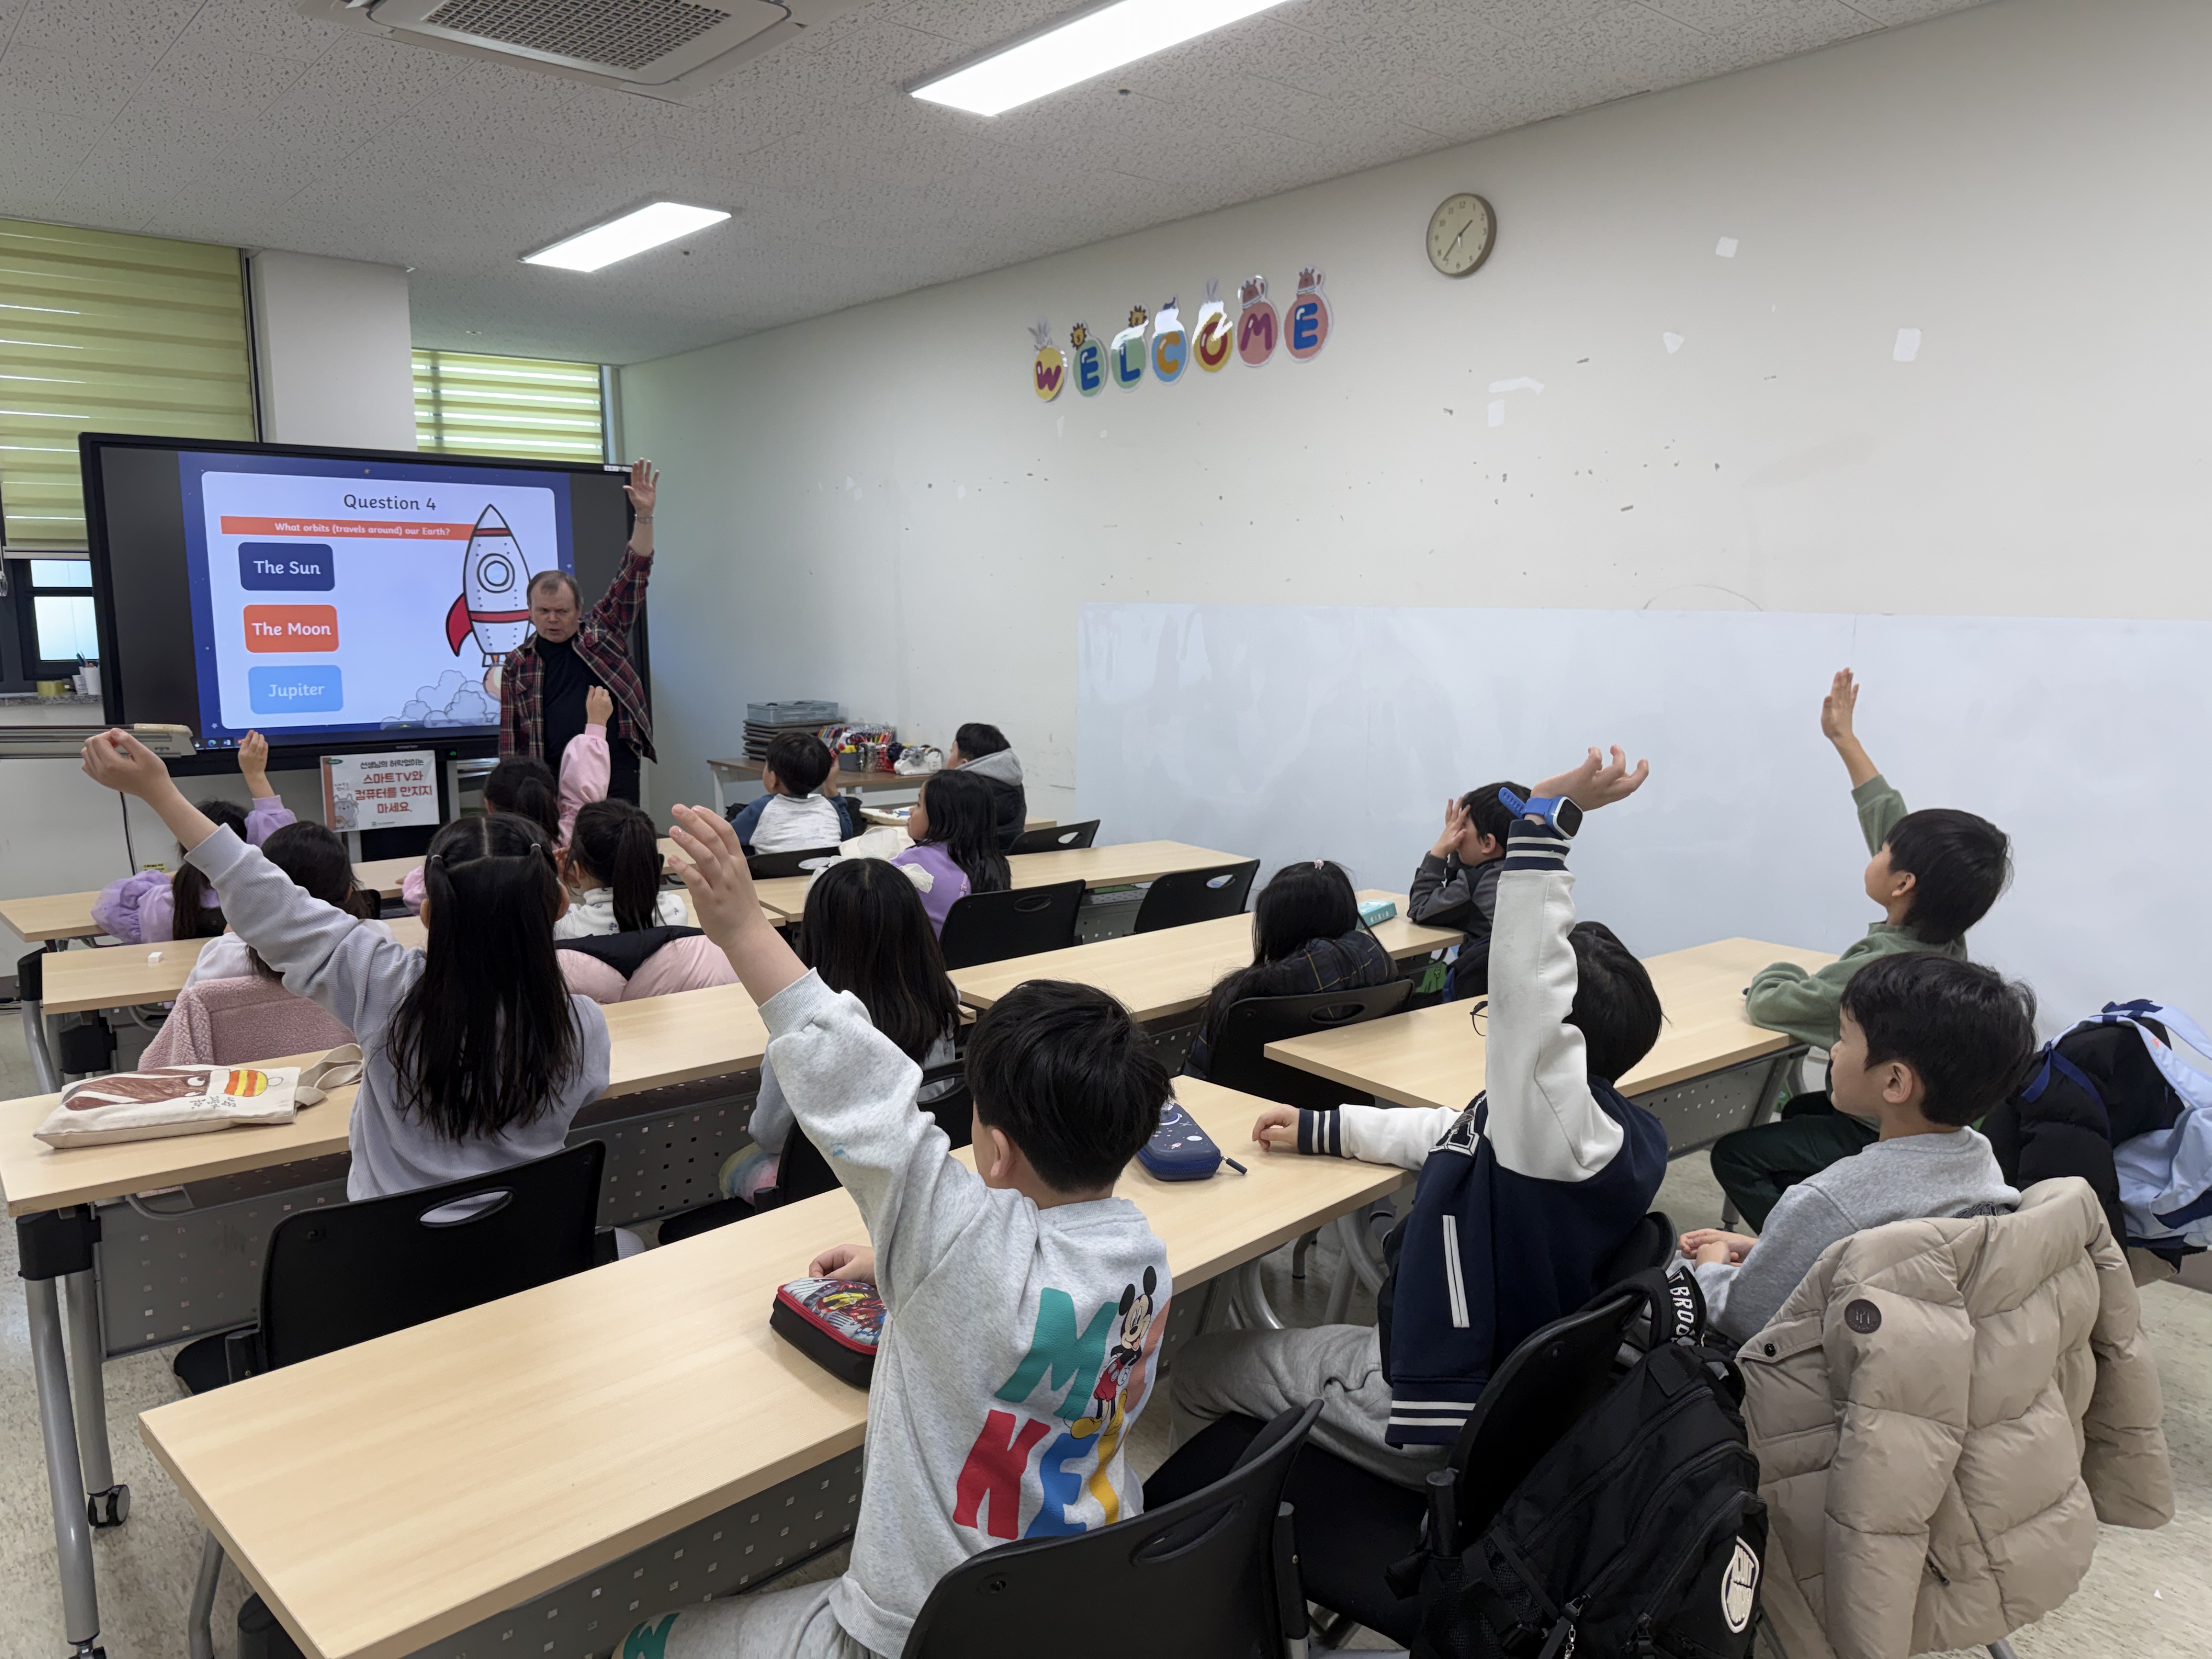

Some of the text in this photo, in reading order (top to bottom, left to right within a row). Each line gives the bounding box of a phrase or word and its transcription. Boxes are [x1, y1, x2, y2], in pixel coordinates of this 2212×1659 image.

[1036, 302, 1319, 391] WELCOME
[343, 494, 437, 510] Question 4
[274, 523, 301, 532] What
[303, 523, 330, 532] orbits
[332, 524, 366, 534] (travels
[368, 526, 403, 535] around)
[422, 527, 450, 535] Earth?
[253, 560, 321, 575] The Sun
[251, 622, 331, 636] The Moon
[268, 683, 325, 699] Jupiter
[360, 760, 388, 769] 선생님의
[363, 771, 424, 785] 스마트TV와
[355, 785, 432, 800] 컴퓨터를 만지지
[377, 802, 413, 814] 마세요.
[1669, 1286, 1694, 1342] BROO
